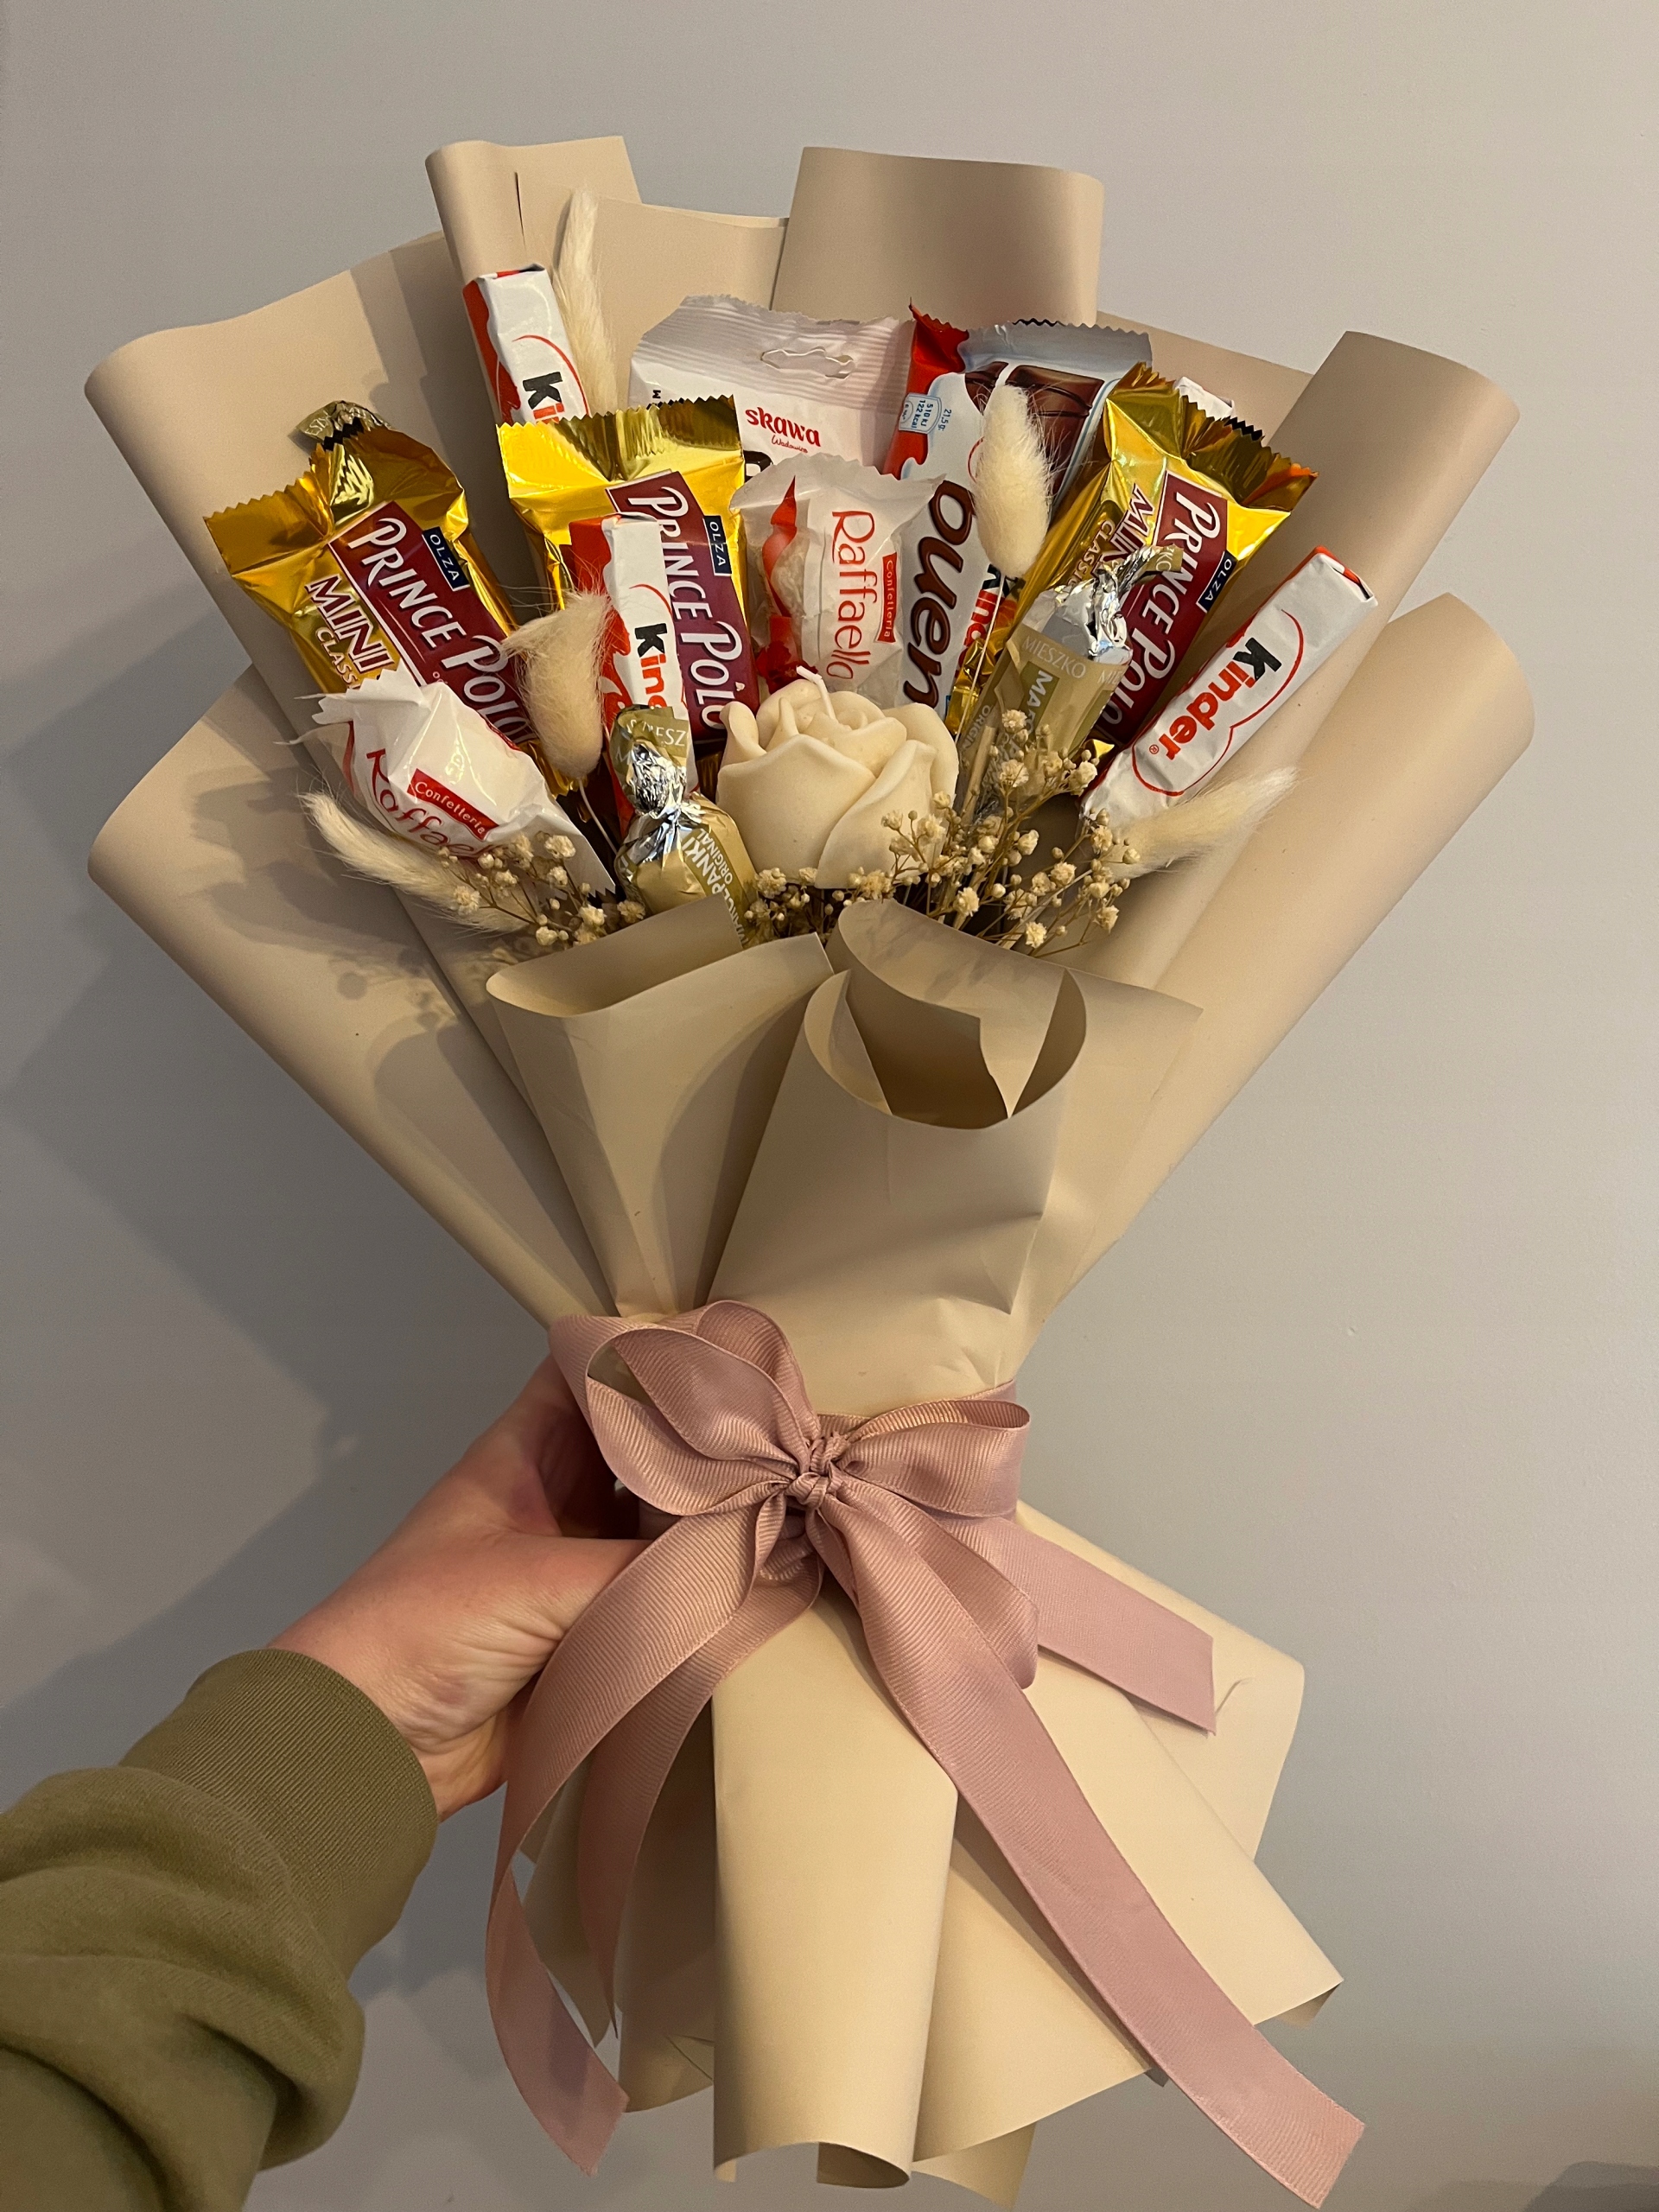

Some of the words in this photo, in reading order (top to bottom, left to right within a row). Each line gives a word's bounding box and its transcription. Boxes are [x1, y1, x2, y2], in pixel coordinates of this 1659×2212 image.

[745, 407, 821, 447] skawa
[916, 399, 926, 412] 122
[429, 533, 459, 581] OLZA
[709, 521, 726, 566] OLZA
[347, 518, 467, 649] PRINCE
[826, 511, 878, 680] Raffaello
[883, 560, 893, 638] Confetteria
[1205, 558, 1232, 601] OLZA
[304, 574, 395, 673] MINI
[315, 626, 360, 690] CLASSI
[680, 620, 743, 729] POLO
[1022, 635, 1086, 678] MIESZKO
[1102, 628, 1175, 724] POLO
[415, 781, 486, 836] Confetteria
[697, 828, 733, 885] ORIGINAL
